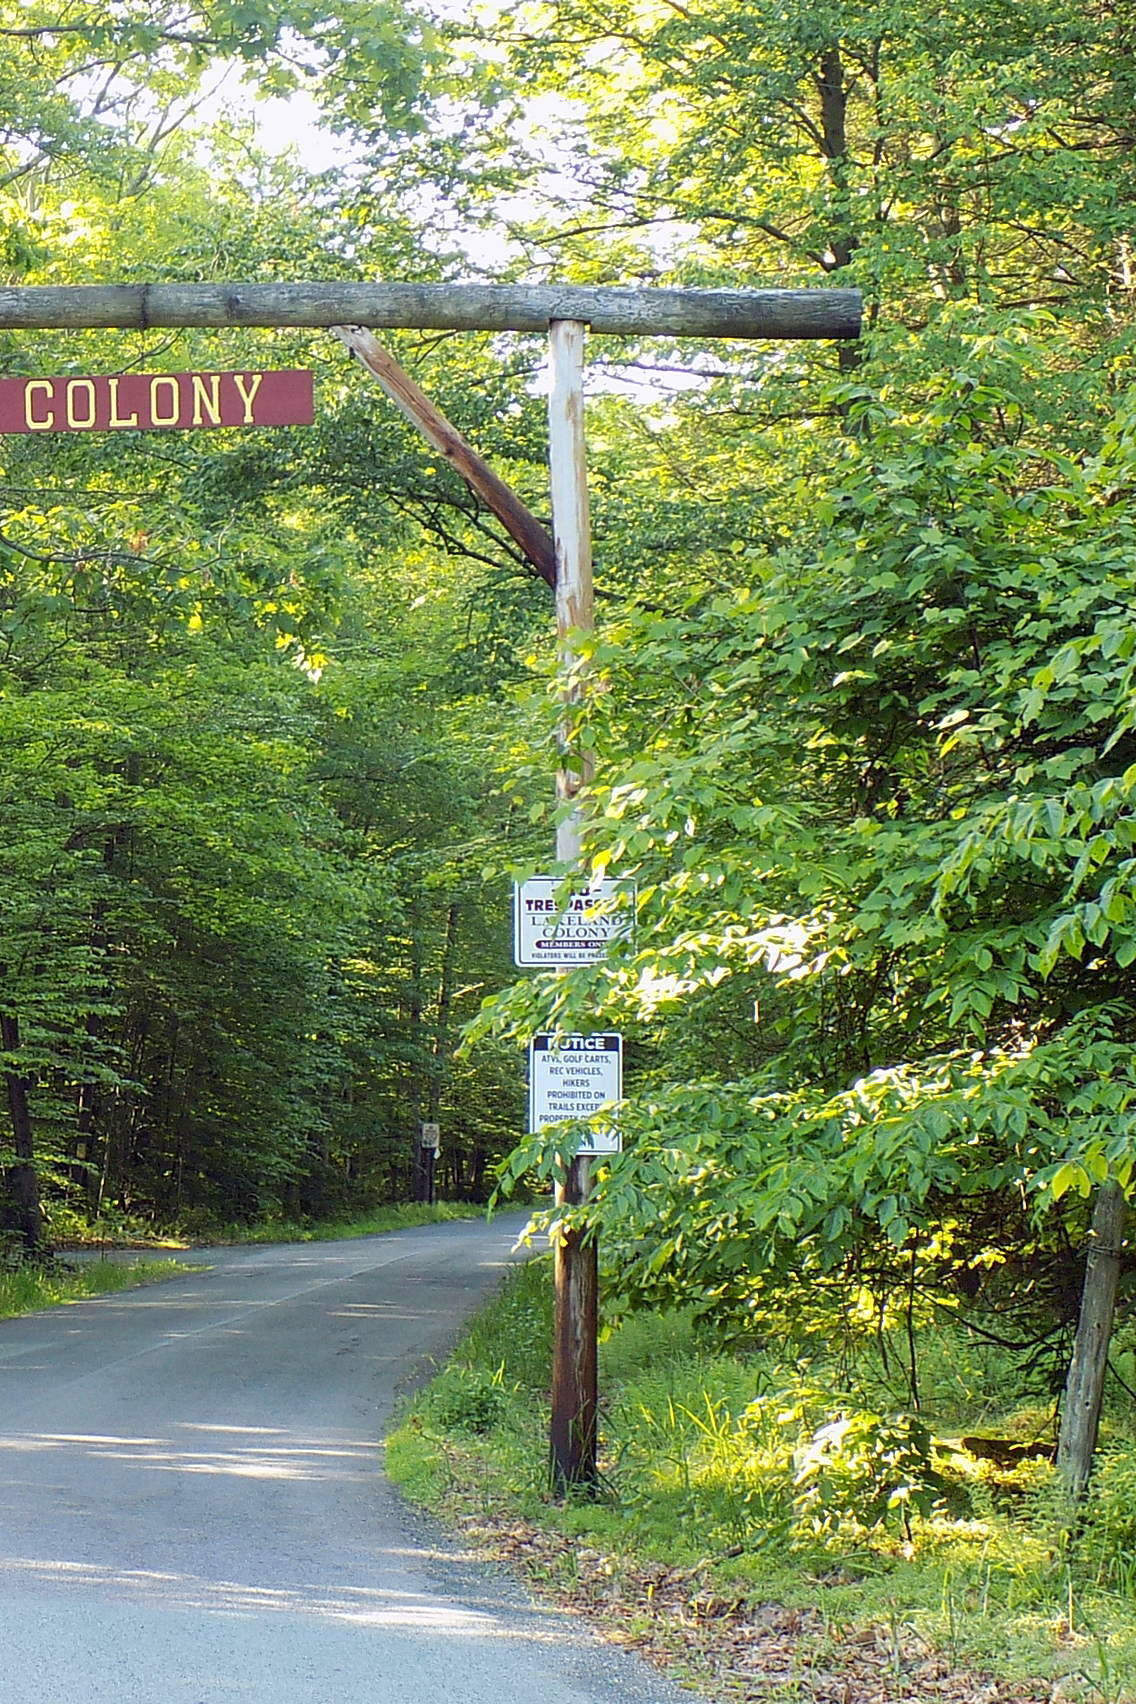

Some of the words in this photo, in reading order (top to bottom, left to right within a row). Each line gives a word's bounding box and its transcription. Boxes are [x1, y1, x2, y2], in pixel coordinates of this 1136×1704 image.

[24, 374, 263, 430] COLONY
[542, 927, 611, 938] COLONY
[563, 1055, 583, 1063] GOLF
[584, 1055, 612, 1064] CARTS,
[549, 1066, 564, 1075] REC
[565, 1066, 604, 1076] VEHICLES,
[562, 1079, 590, 1087] HIKERS
[547, 1091, 592, 1099] PROHIBITED
[593, 1091, 606, 1099] ON
[548, 1103, 575, 1111] TRAILS
[576, 1103, 602, 1111] EXCEP
